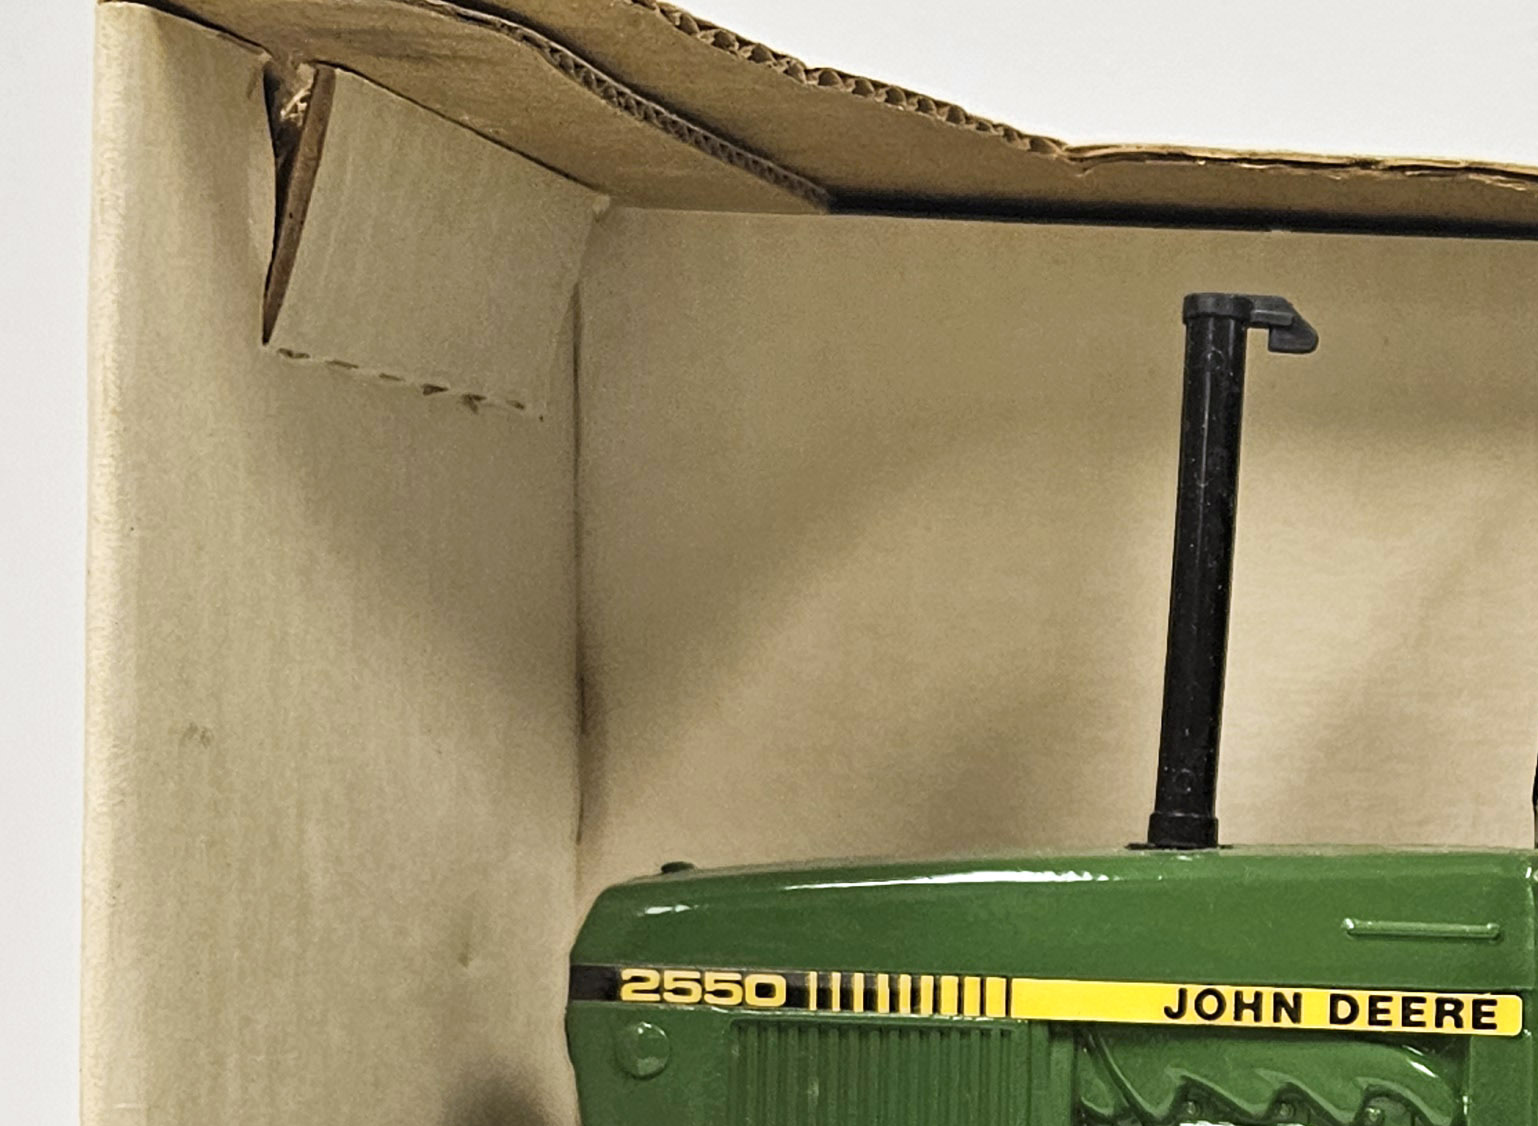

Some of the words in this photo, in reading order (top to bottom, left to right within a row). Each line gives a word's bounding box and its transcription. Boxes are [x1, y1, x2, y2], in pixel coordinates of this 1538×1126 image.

[621, 968, 786, 1007] 2550
[1164, 987, 1303, 1024] JOHN
[1328, 993, 1498, 1030] DEERE
